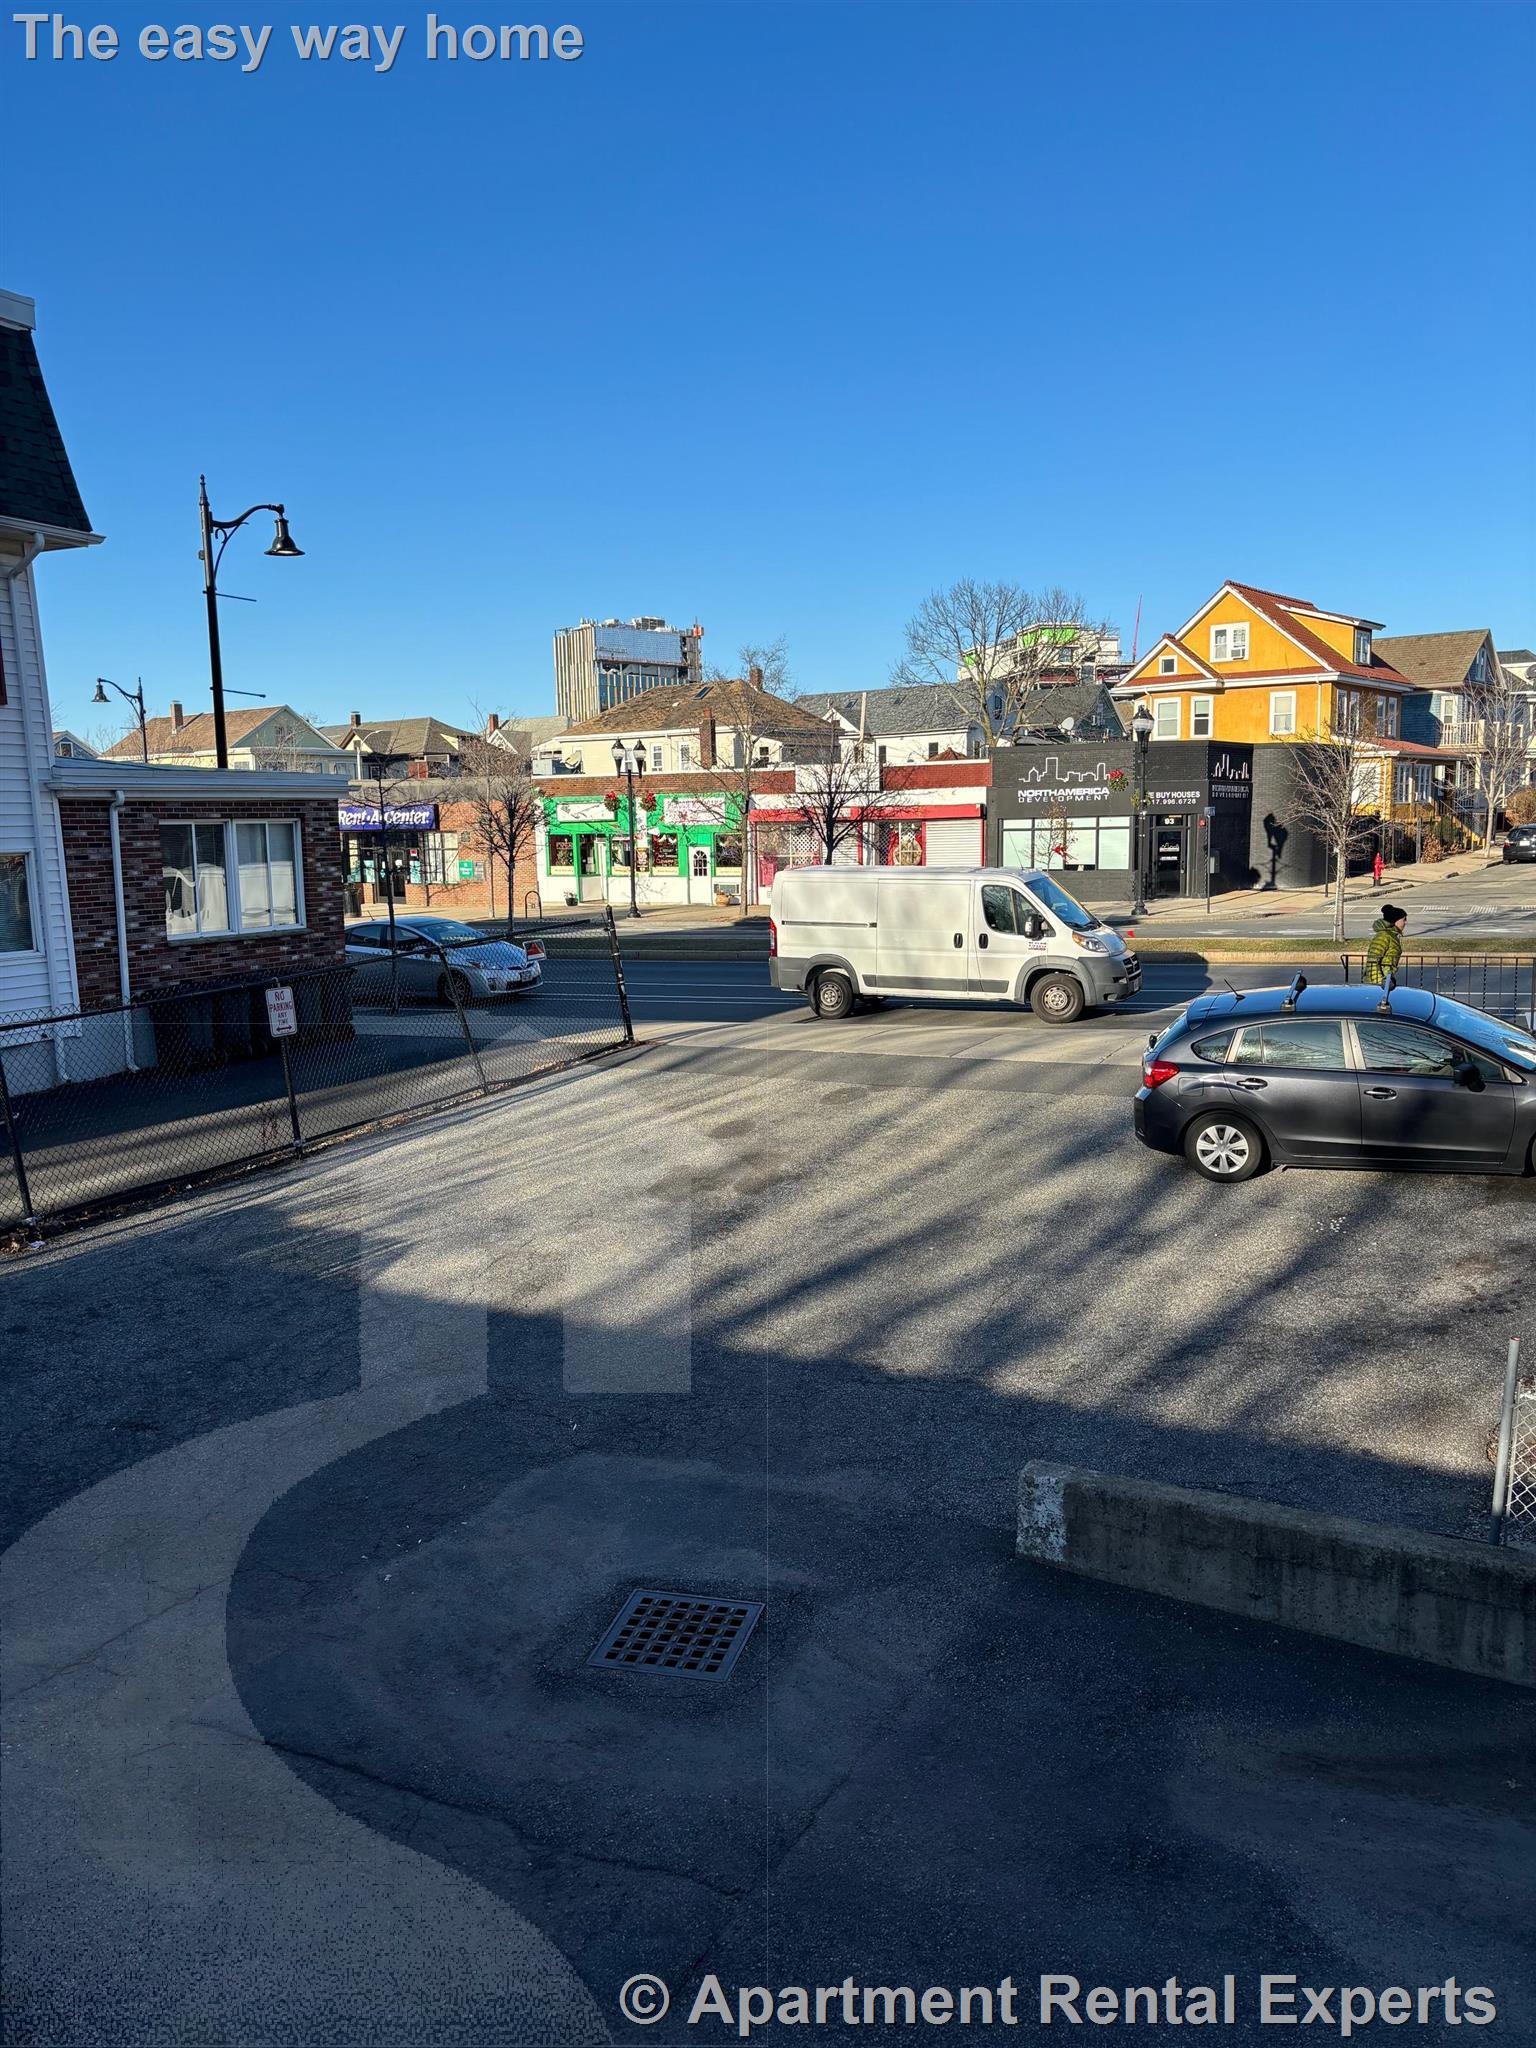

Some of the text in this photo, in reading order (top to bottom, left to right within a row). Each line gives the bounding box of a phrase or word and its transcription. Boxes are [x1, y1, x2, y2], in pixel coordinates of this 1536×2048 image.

[1018, 794, 1110, 803] DEVELOPMENT
[1155, 791, 1171, 799] BUY
[1171, 790, 1201, 799] HOUSES
[274, 990, 285, 1001] NO
[269, 1000, 293, 1012] PARKING
